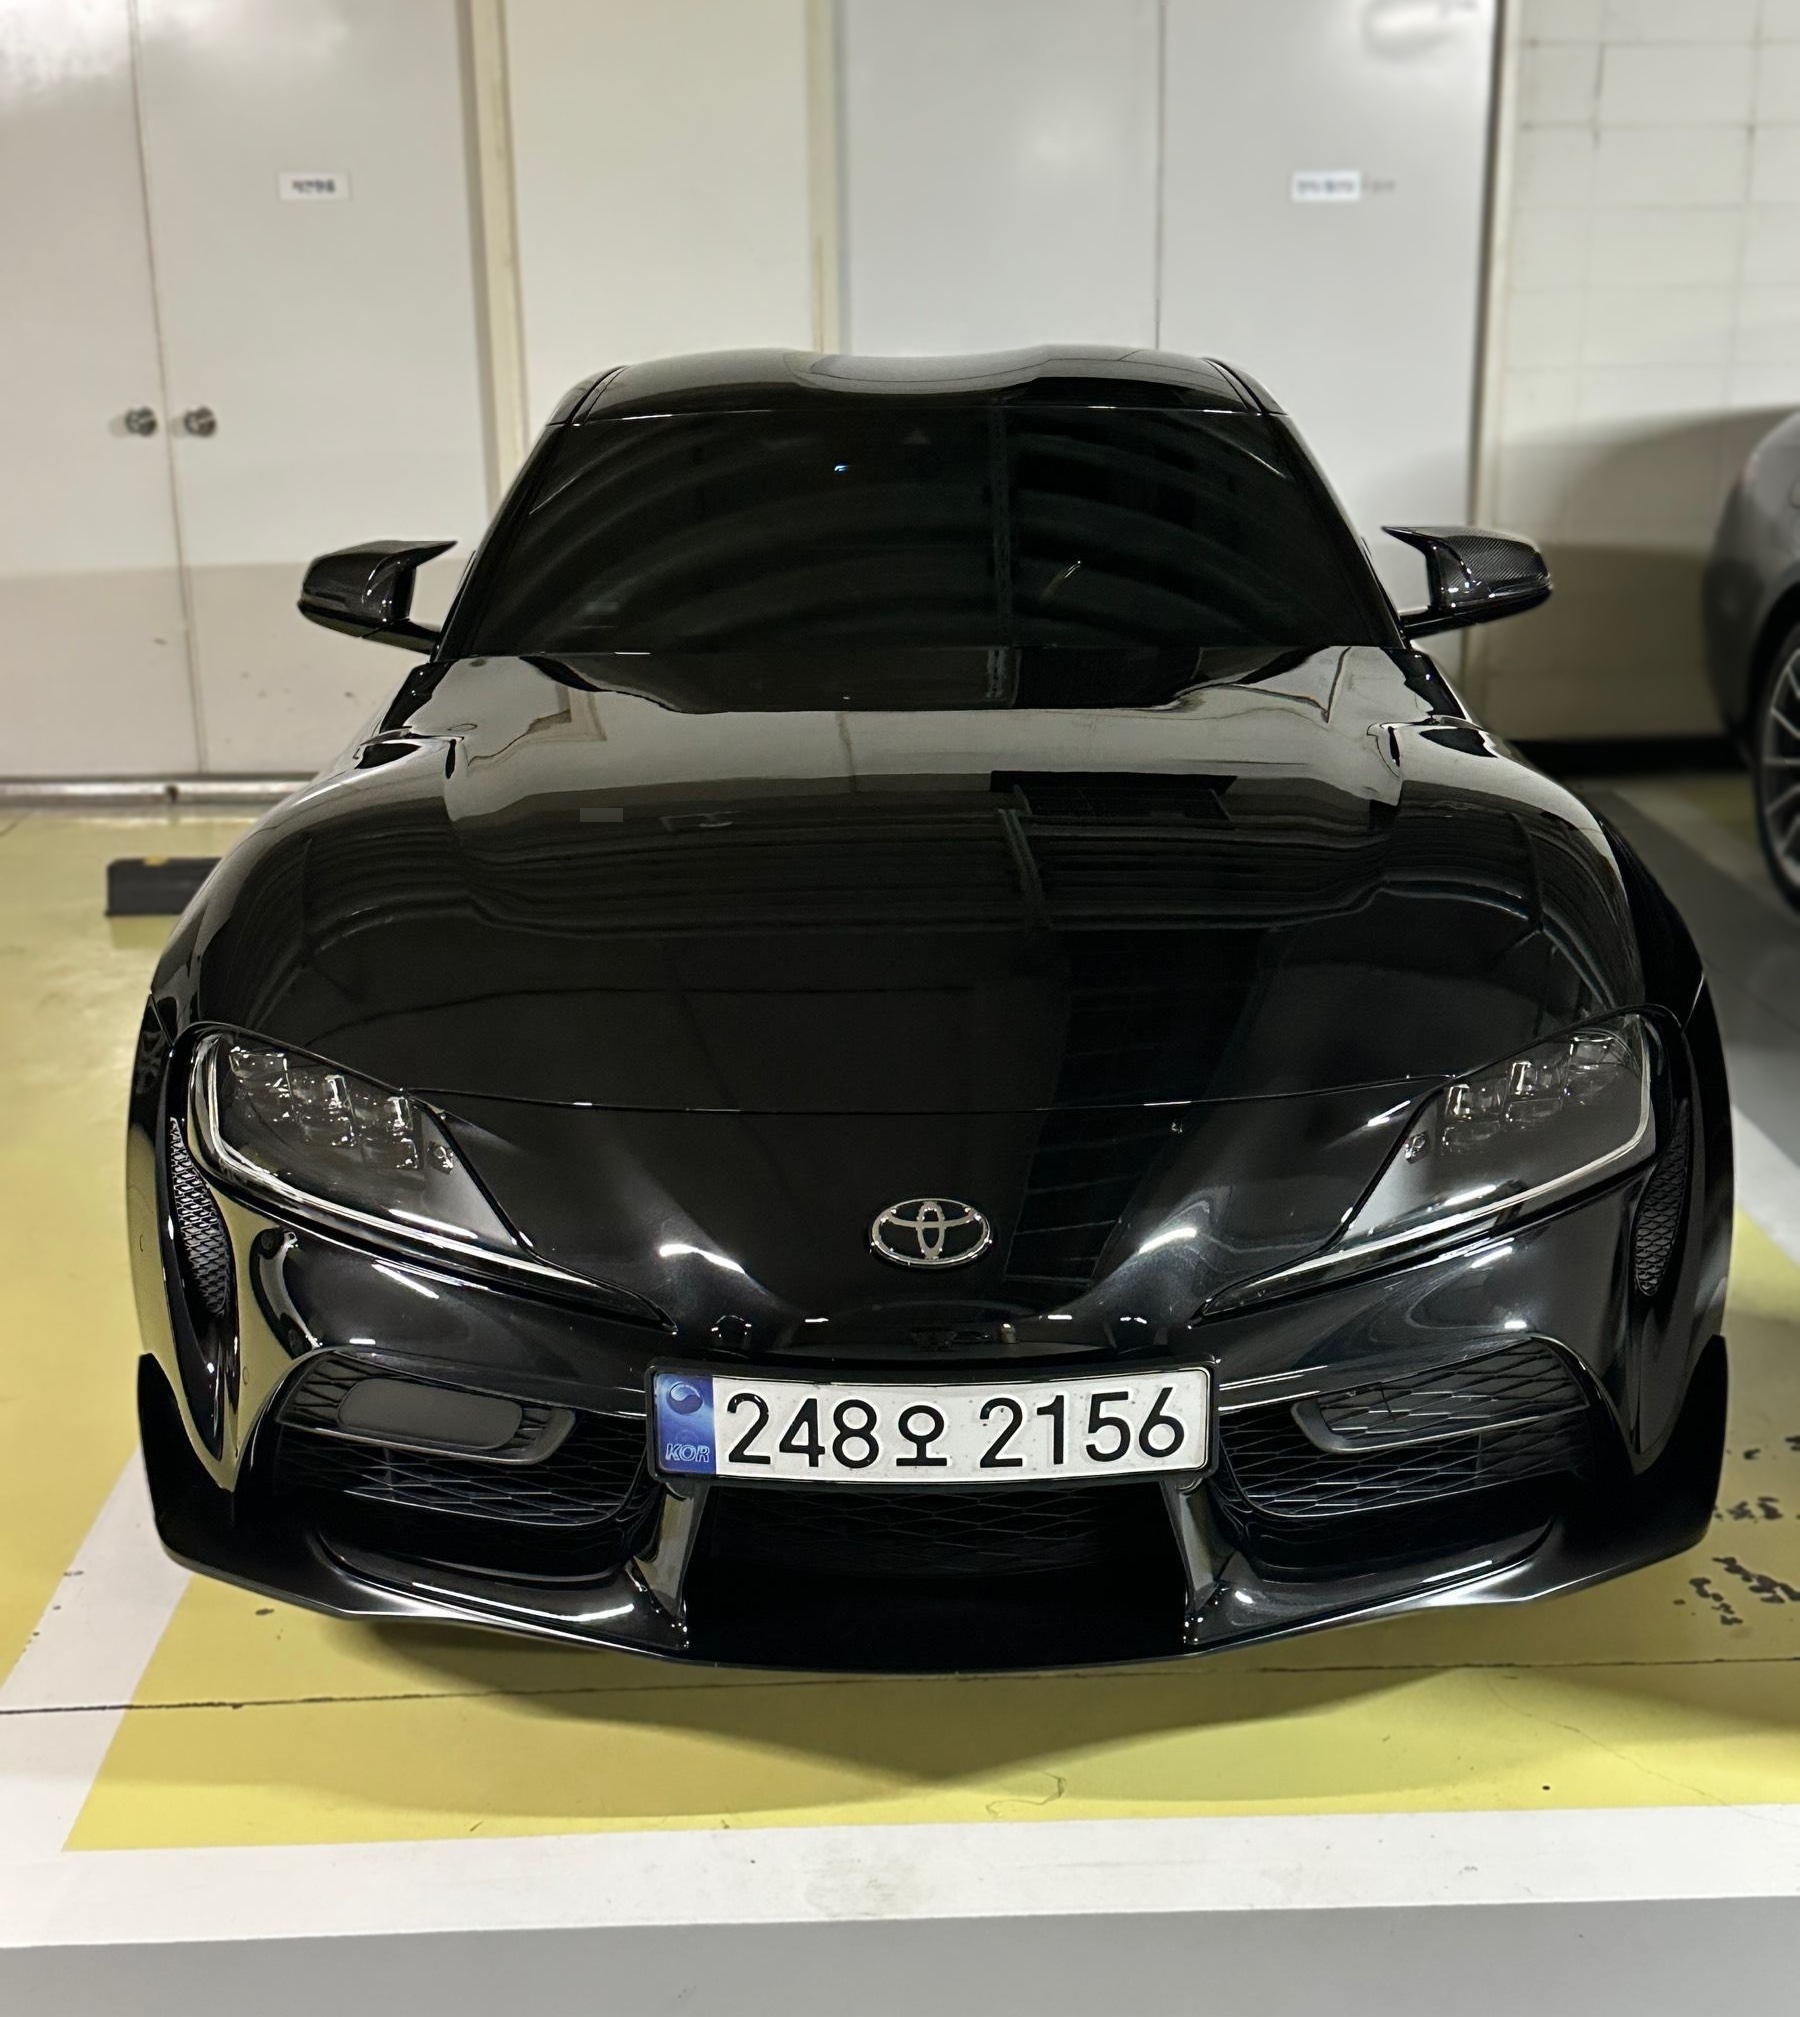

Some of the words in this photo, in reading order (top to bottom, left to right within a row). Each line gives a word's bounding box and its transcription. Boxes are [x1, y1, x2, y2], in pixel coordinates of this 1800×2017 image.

[727, 1392, 948, 1468] 248오
[979, 1387, 1186, 1468] 2156
[665, 1443, 710, 1463] KOR
